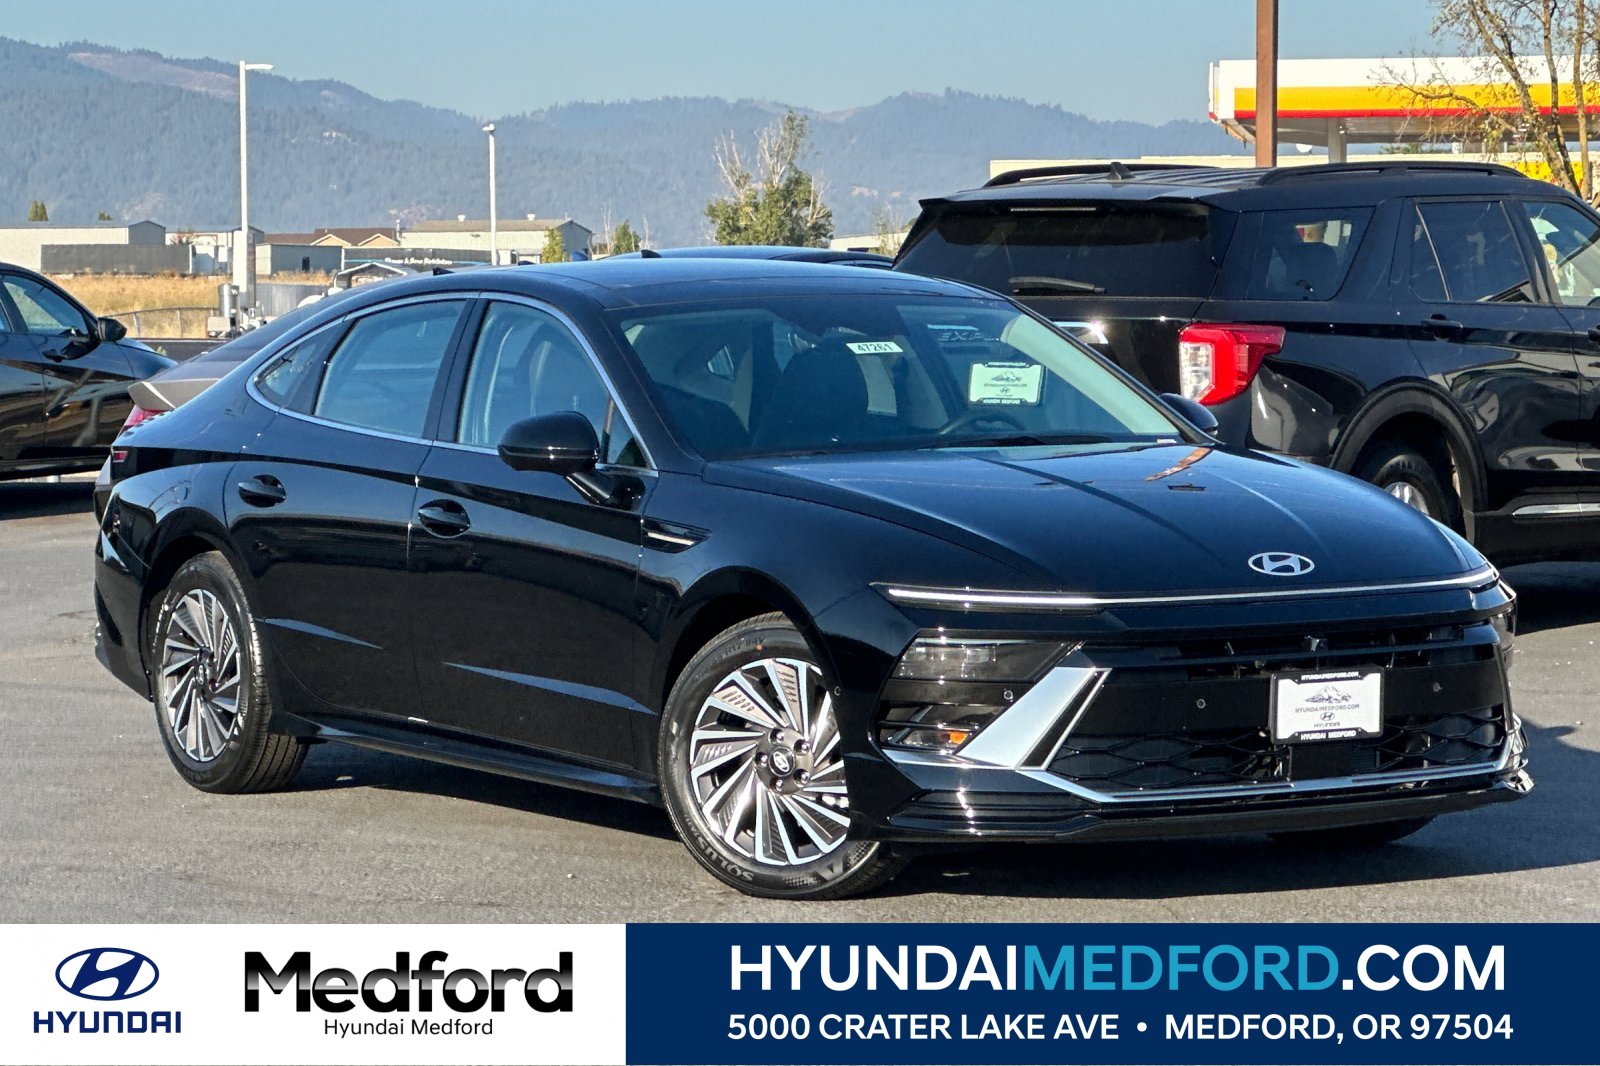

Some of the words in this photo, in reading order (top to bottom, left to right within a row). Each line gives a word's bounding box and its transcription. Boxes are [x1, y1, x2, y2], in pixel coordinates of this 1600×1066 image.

[857, 343, 894, 352] 47261
[1295, 704, 1360, 713] HYUNDAIMEDFORD.COM
[696, 836, 754, 882] SOLUS
